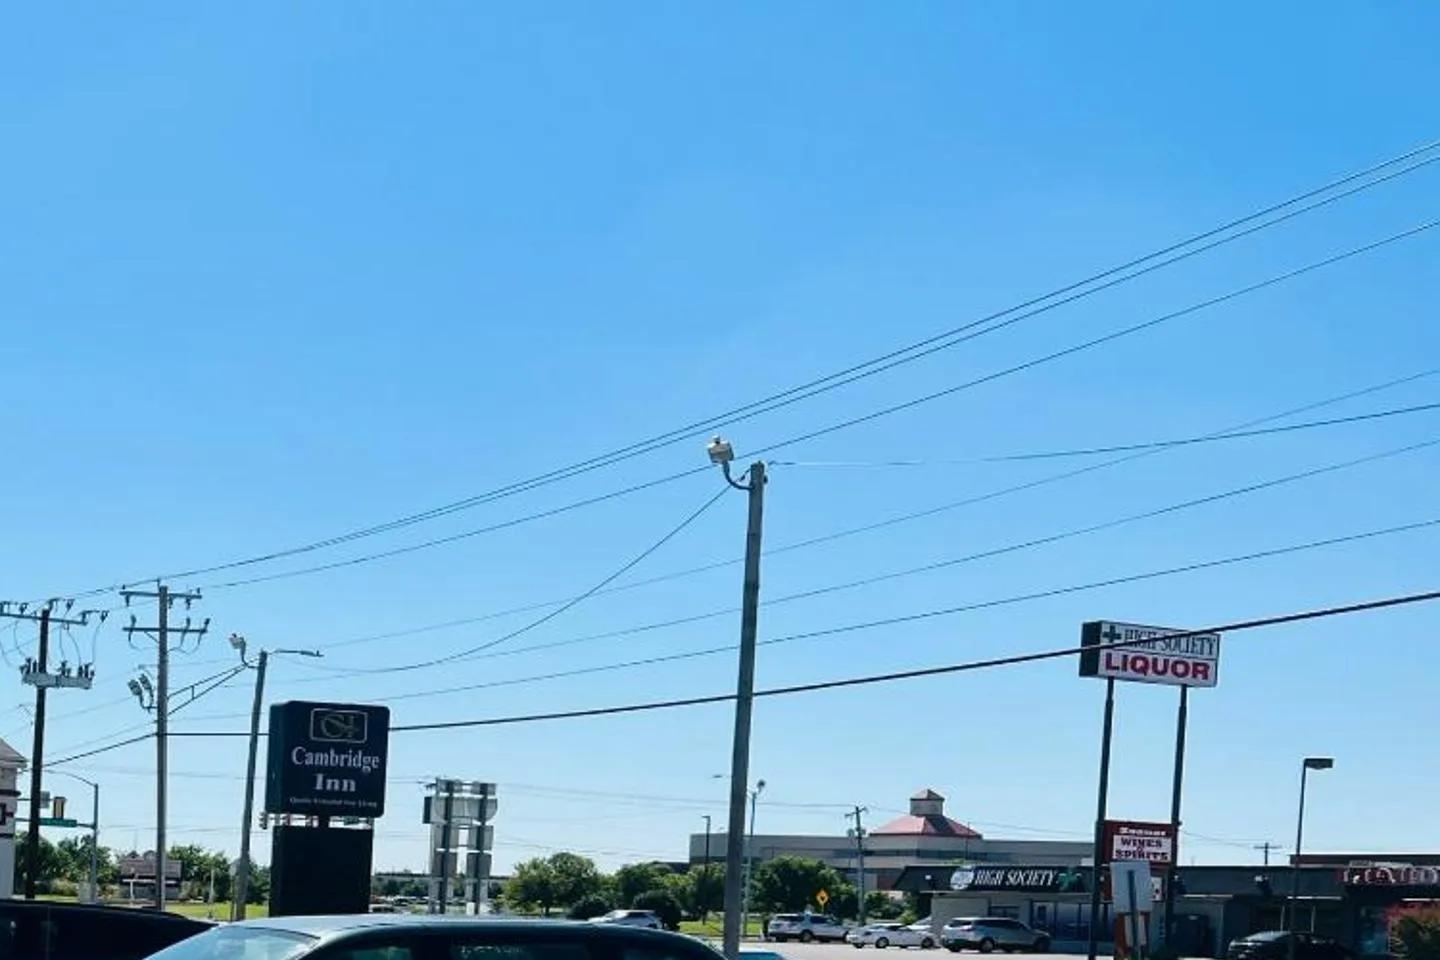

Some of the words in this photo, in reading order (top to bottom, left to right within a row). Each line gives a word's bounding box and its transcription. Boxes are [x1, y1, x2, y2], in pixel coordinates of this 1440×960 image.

[1105, 652, 1209, 680] LIQUOR
[291, 746, 379, 773] Cambridge
[314, 773, 356, 792] Inn
[1121, 837, 1162, 848] WINES
[1115, 850, 1168, 861] SPIRITS
[974, 869, 1005, 886] HIGH
[1005, 869, 1057, 887] SOCIETY
